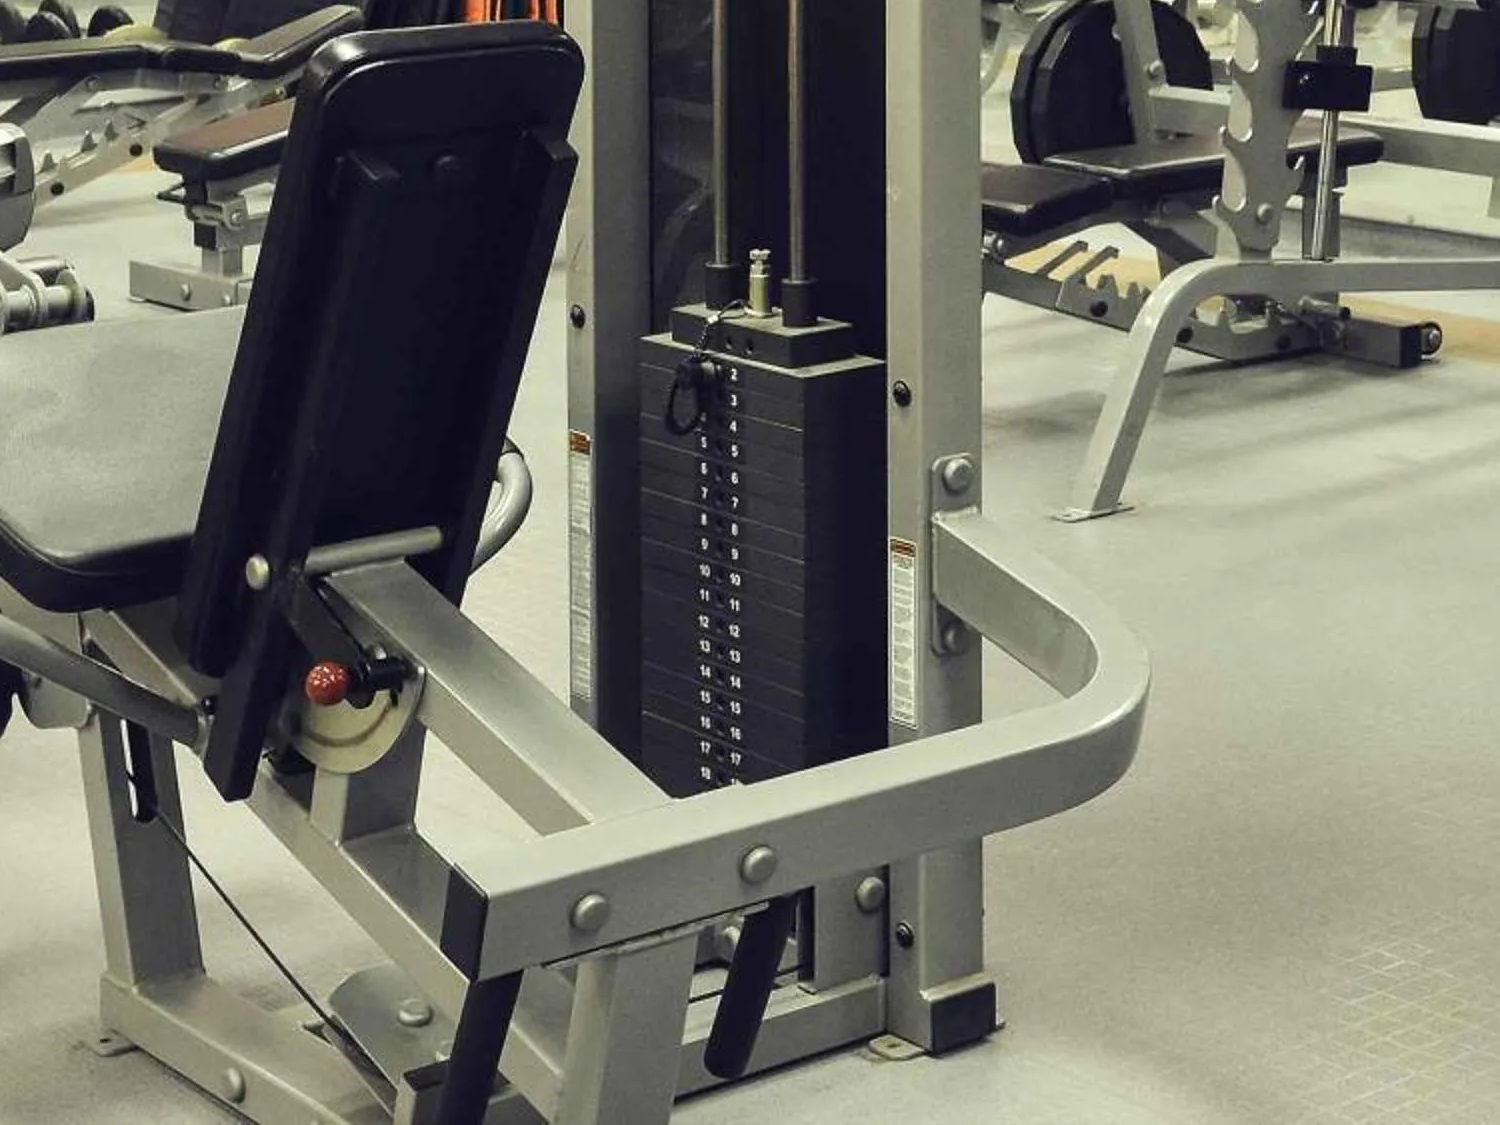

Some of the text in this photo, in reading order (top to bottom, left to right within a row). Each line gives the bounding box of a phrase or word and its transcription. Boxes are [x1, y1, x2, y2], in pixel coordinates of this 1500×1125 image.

[730, 367, 738, 382] 2
[731, 444, 739, 458] 5
[731, 471, 739, 485] 6
[701, 486, 709, 499] 7
[731, 496, 739, 509] 7
[699, 564, 711, 578] 10
[729, 572, 741, 587] 10
[699, 588, 710, 602] 11
[729, 598, 740, 612] 11
[698, 614, 710, 629] 12
[728, 624, 741, 638] 12
[699, 639, 711, 653] 13
[729, 649, 741, 664] 13
[699, 664, 711, 678] 14
[729, 675, 741, 689] 14
